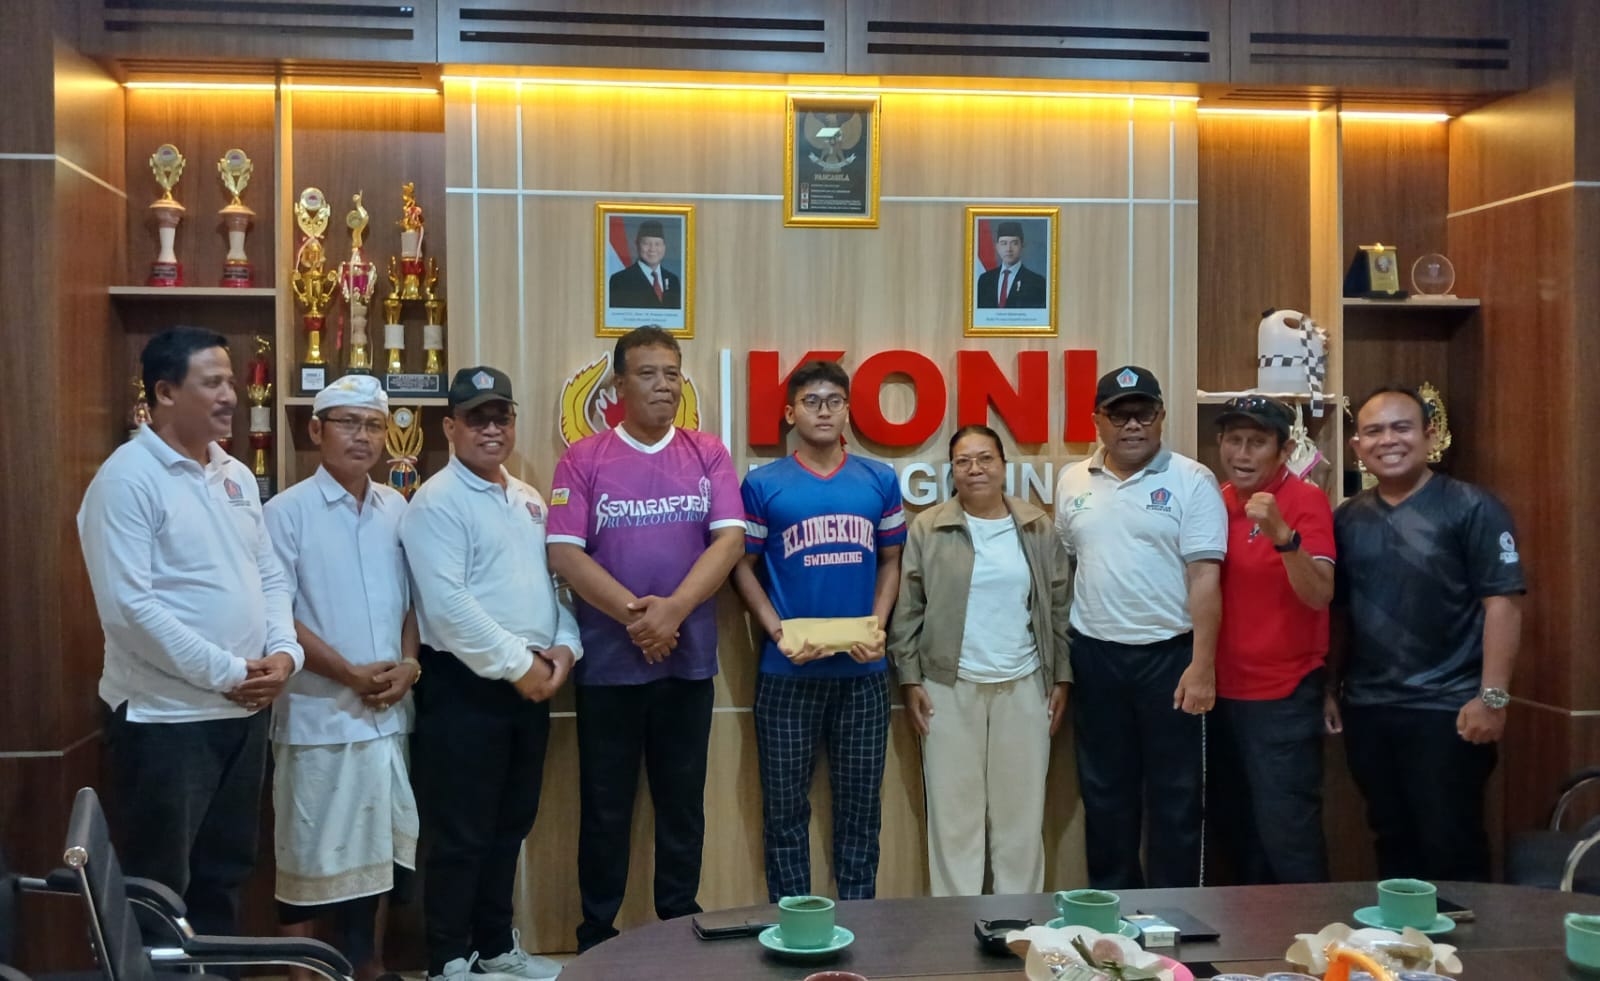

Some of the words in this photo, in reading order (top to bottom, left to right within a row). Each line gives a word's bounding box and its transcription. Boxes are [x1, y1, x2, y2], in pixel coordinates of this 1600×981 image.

[748, 350, 1097, 446] KONI
[782, 514, 874, 559] KLUNGKUNG
[804, 552, 862, 566] SWIMMING
